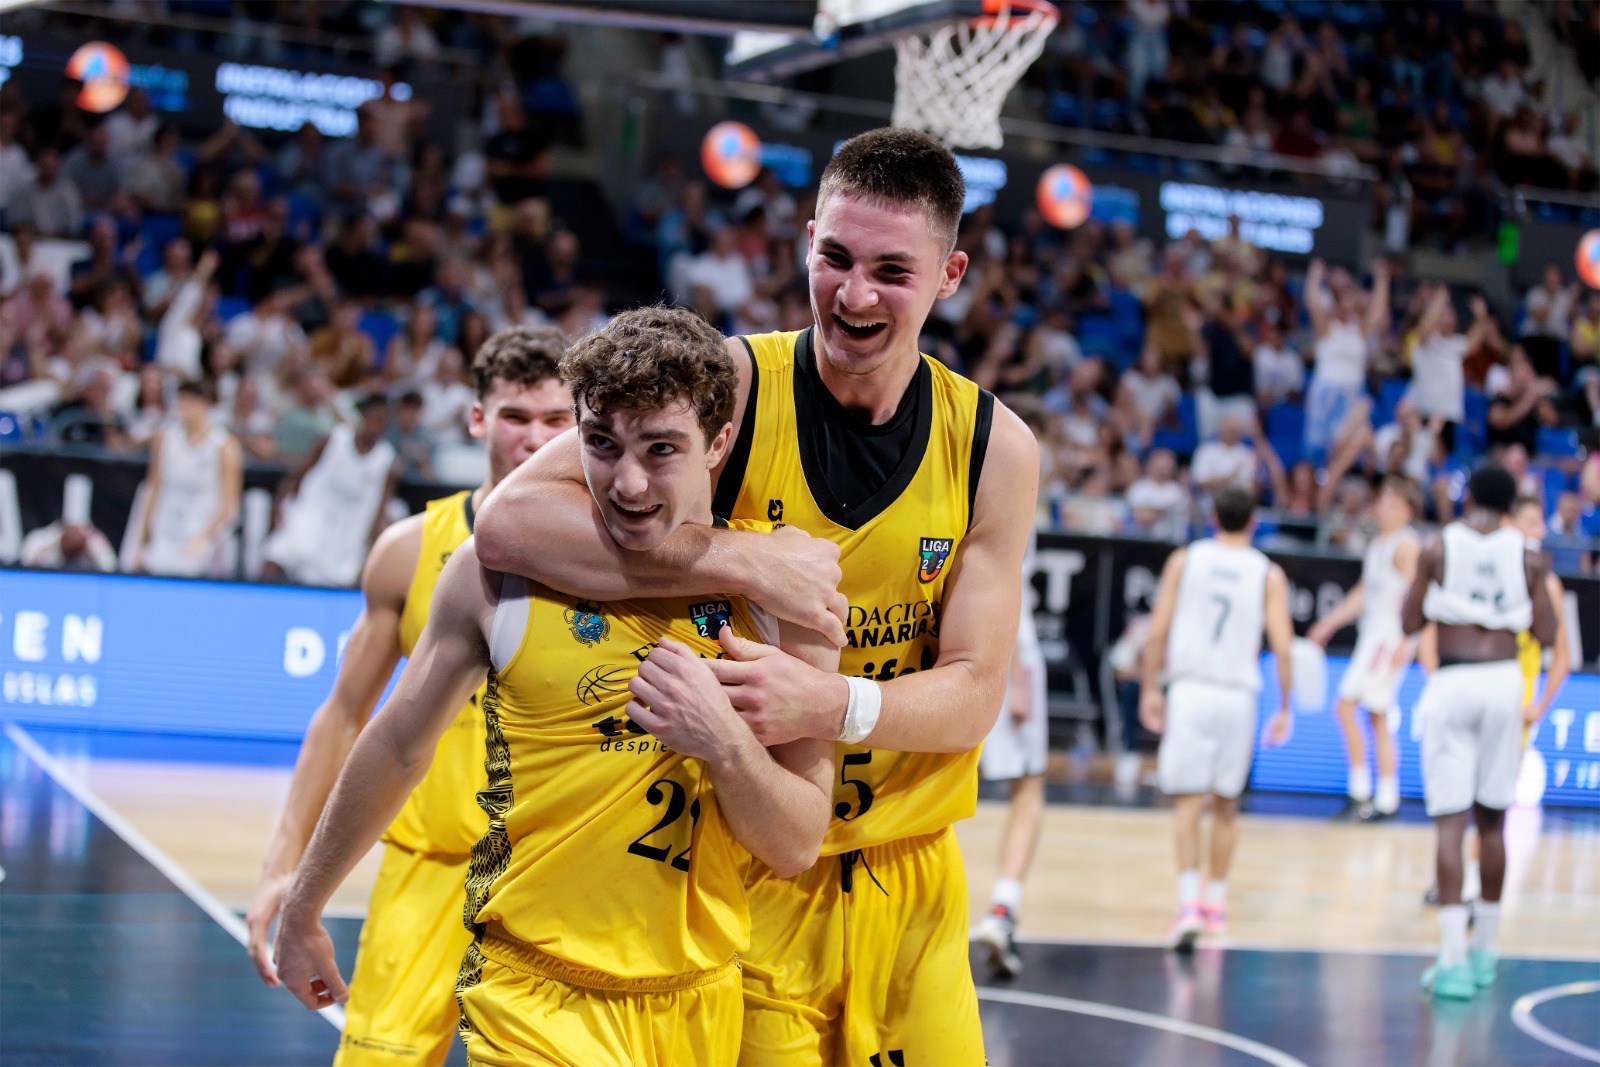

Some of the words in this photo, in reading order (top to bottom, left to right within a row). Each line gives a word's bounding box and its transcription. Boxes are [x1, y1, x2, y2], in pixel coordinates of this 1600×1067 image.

[922, 540, 949, 551] LIGA
[692, 603, 727, 618] LIGA
[1211, 594, 1231, 645] 7
[0, 611, 103, 665] EN
[600, 737, 668, 755] despie
